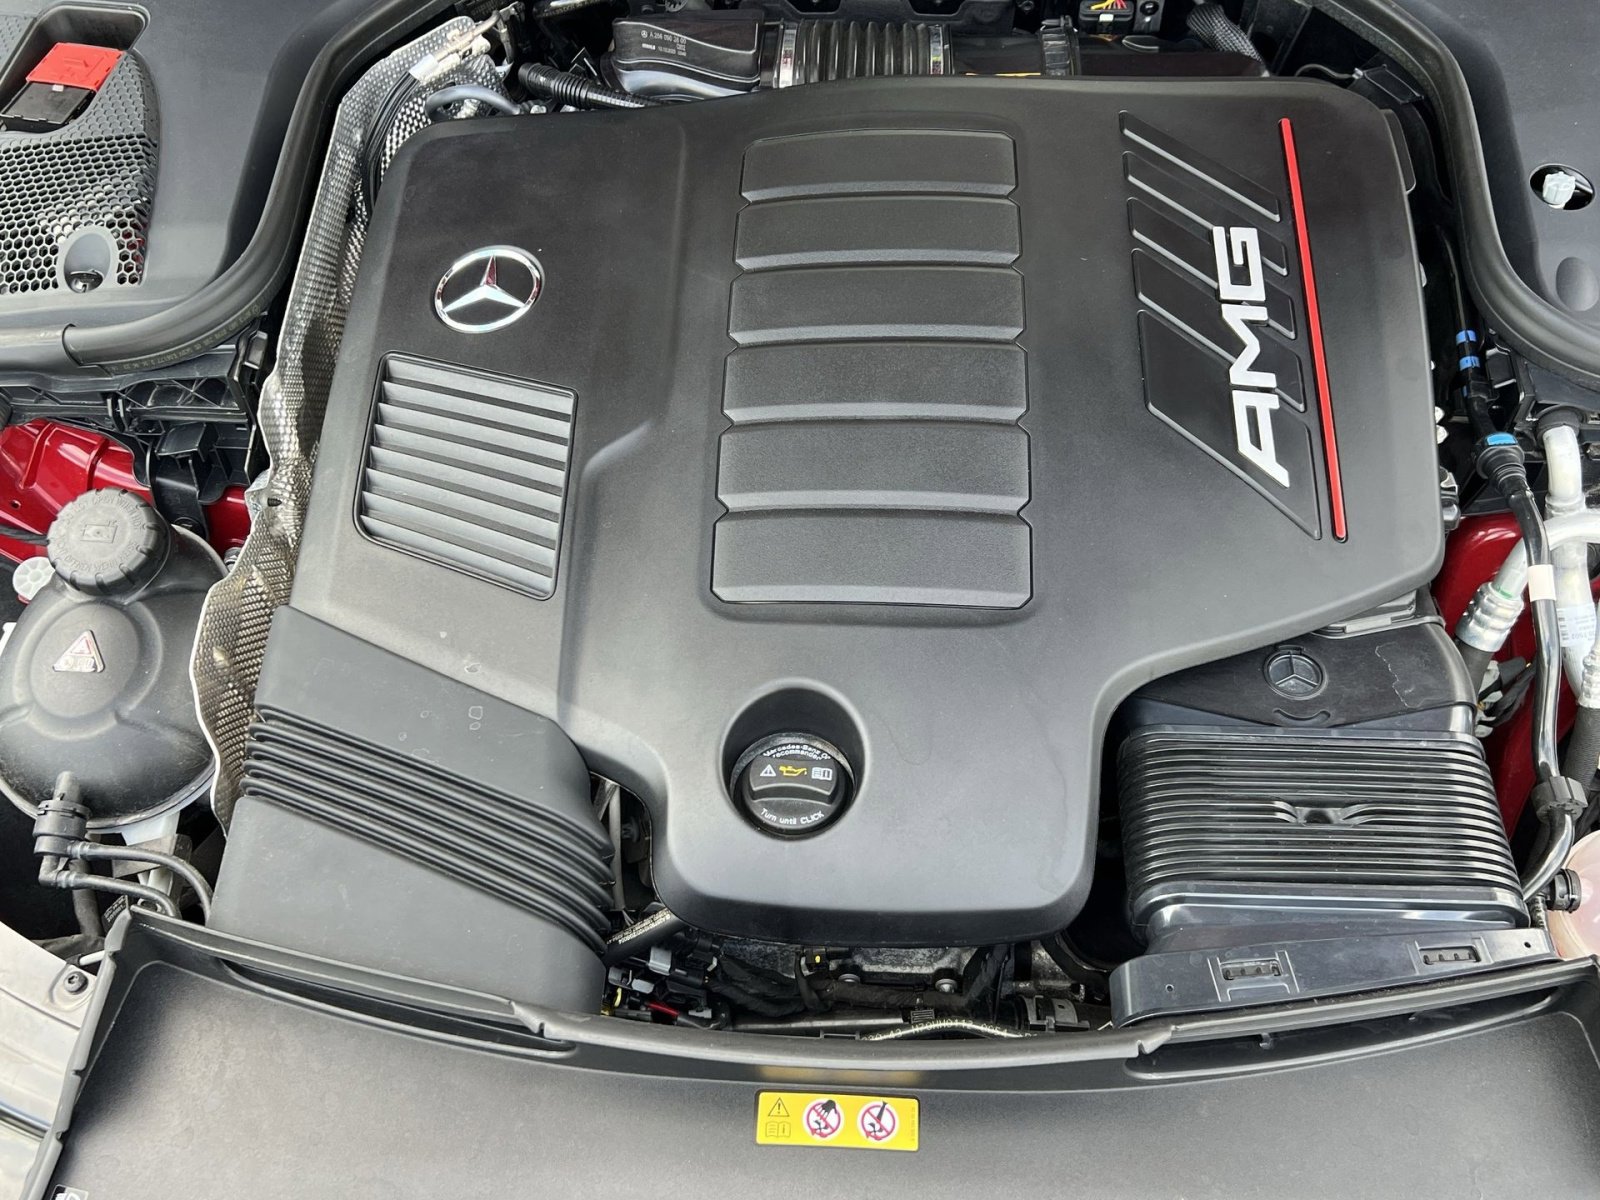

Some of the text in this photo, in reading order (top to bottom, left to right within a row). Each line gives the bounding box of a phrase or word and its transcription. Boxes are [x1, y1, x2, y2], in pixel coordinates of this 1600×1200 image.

[1212, 226, 1290, 488] AMG
[761, 807, 825, 825] Turn until CLICK
